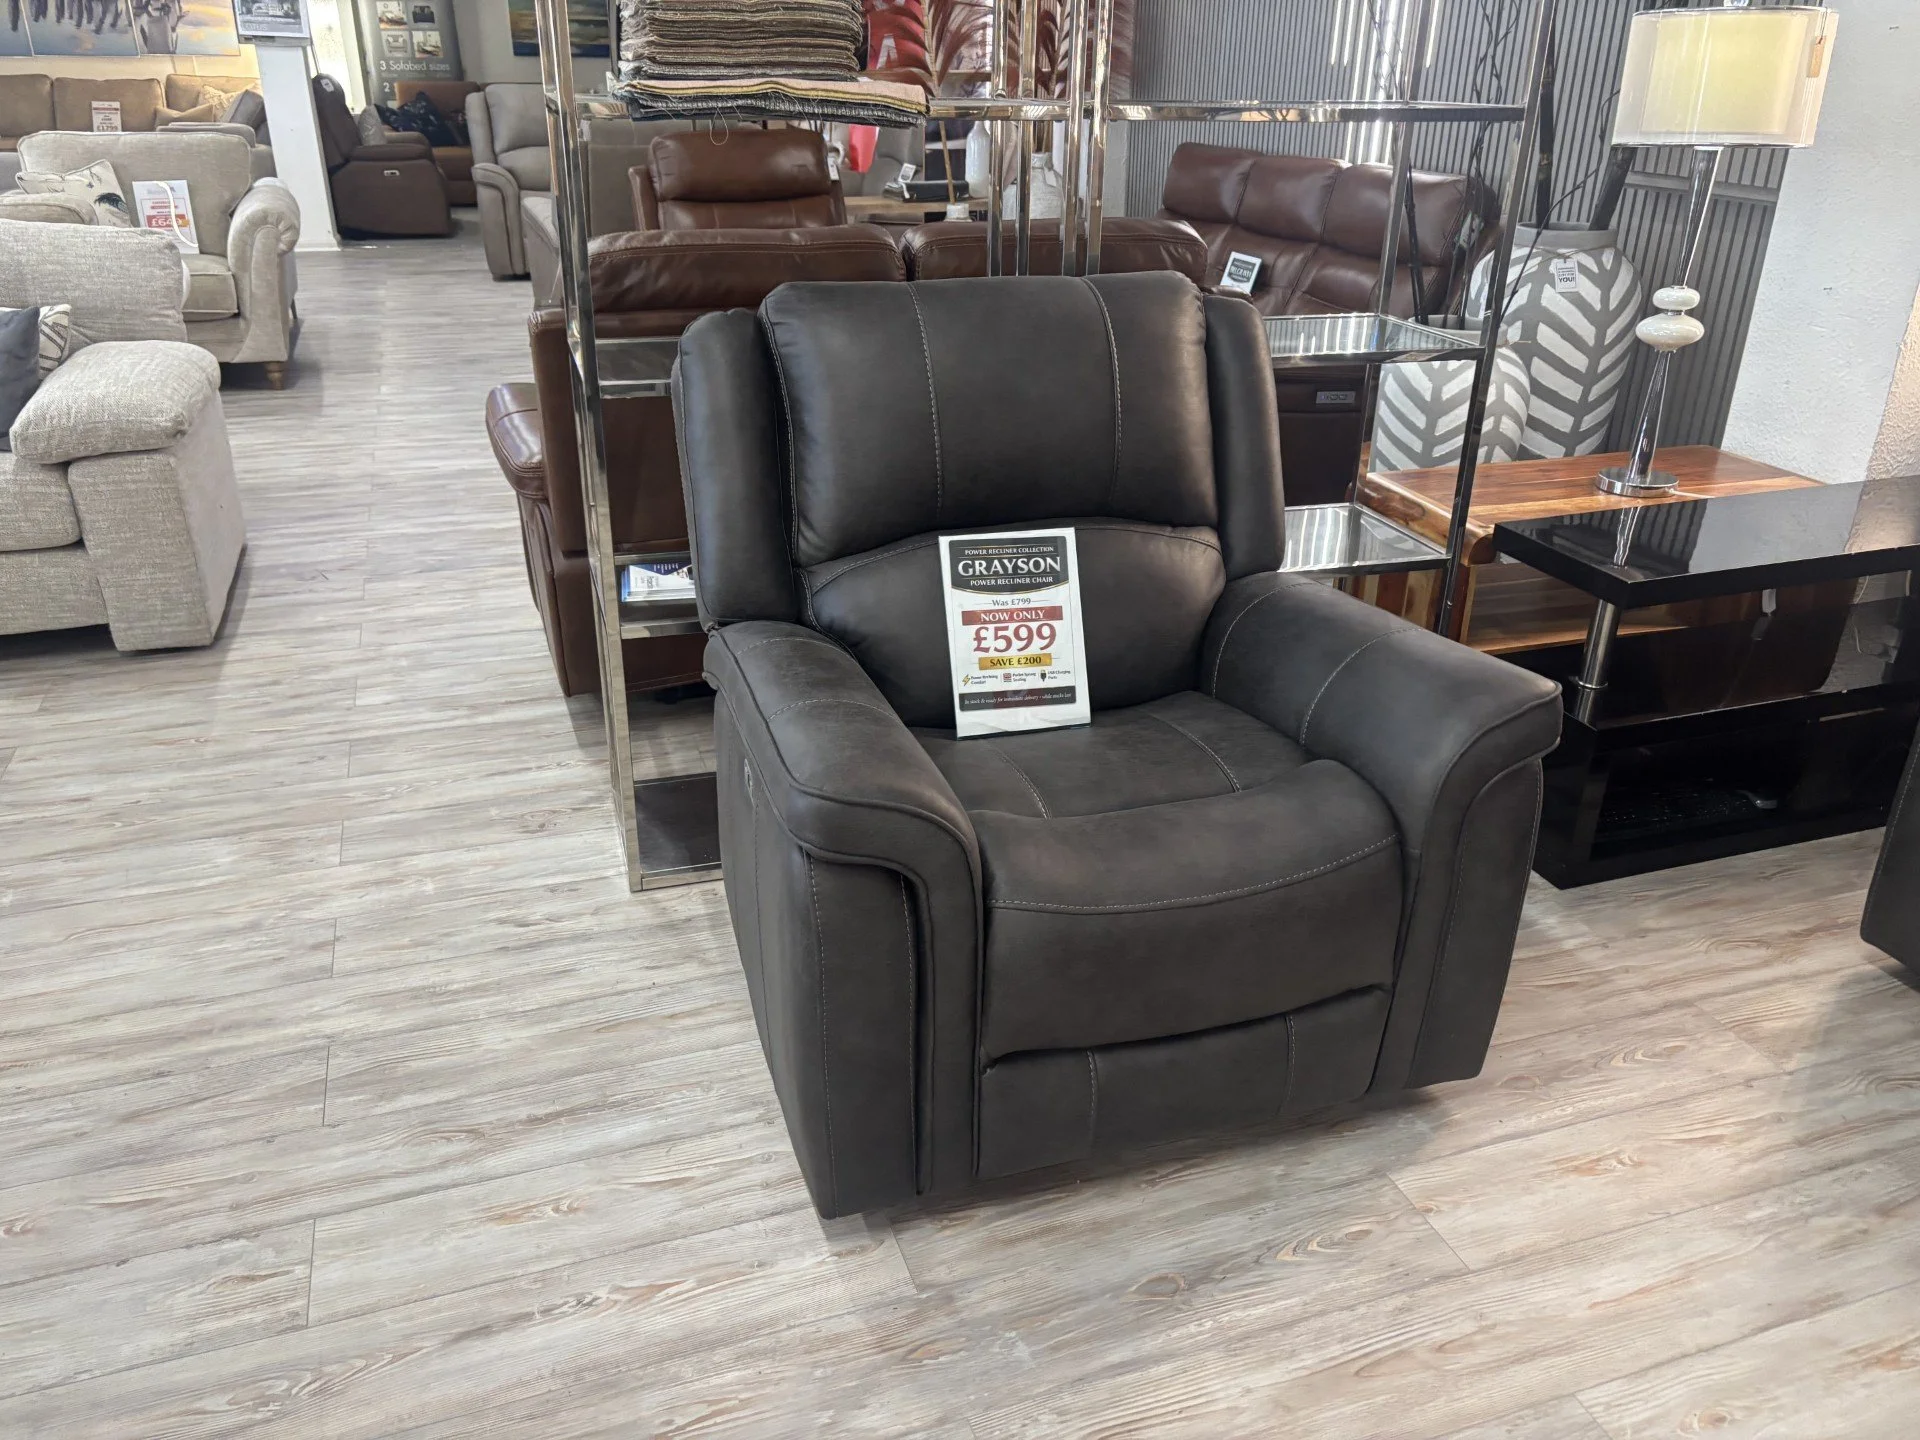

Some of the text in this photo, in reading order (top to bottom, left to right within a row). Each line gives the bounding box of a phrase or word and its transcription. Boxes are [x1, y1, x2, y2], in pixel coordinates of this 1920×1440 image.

[380, 60, 387, 71] 3
[389, 60, 427, 71] Sofabed
[383, 82, 390, 93] 2
[958, 556, 1061, 576] GRAYSON
[997, 577, 1031, 585] RECLINER
[1011, 598, 1031, 606] £799
[980, 609, 1046, 622] NOW ONLY
[972, 622, 1057, 654] £599
[990, 656, 1042, 667] SAVE £200
